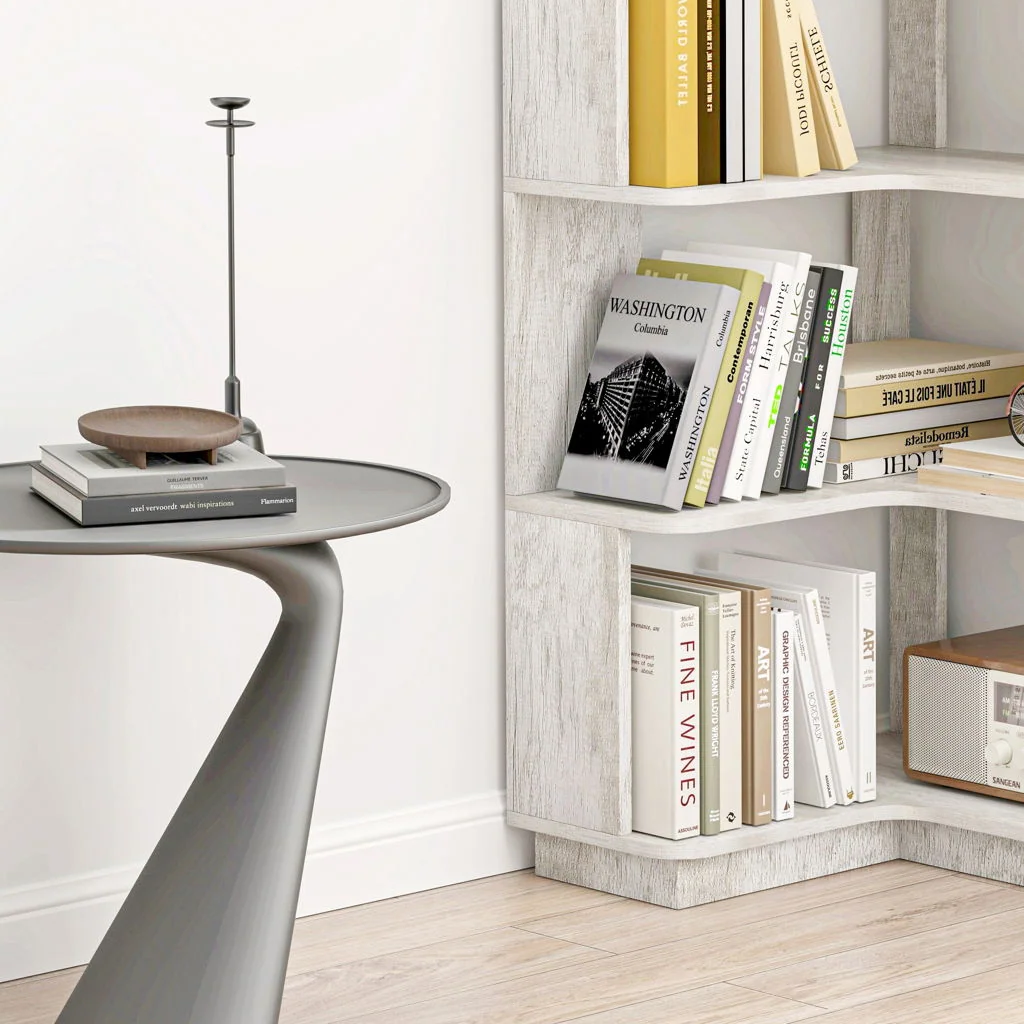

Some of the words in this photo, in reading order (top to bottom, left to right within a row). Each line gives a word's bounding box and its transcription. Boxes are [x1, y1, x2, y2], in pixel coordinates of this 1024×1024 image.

[610, 297, 707, 323] WASHINGTON
[634, 322, 669, 336] Columbia
[831, 289, 853, 357] Houston
[737, 360, 753, 404] FORM
[749, 305, 766, 354] STYLE
[800, 414, 816, 472] FORMULA
[814, 364, 824, 390] FOR
[822, 288, 838, 343] SUCCESS
[678, 385, 711, 481] WASHINGTON
[716, 309, 731, 347] Columbia
[735, 448, 750, 482] State
[744, 397, 761, 444] Capital
[759, 281, 790, 370] Harrisburg
[774, 416, 791, 478] Queensland
[793, 288, 816, 363] Brisbane
[130, 503, 145, 513] axel
[146, 503, 178, 512] vervoordt
[179, 501, 196, 510] wabi
[197, 500, 235, 511] inspirations
[260, 497, 294, 506] Flammarion
[680, 640, 695, 703] FINE
[757, 645, 770, 681] ART
[782, 630, 790, 674] GRAPHIC
[863, 628, 875, 662] ART
[782, 676, 790, 713] DESIGN
[680, 714, 696, 807] WINES
[782, 715, 790, 780] REFERENCED
[992, 776, 1021, 789] SANGEAN
